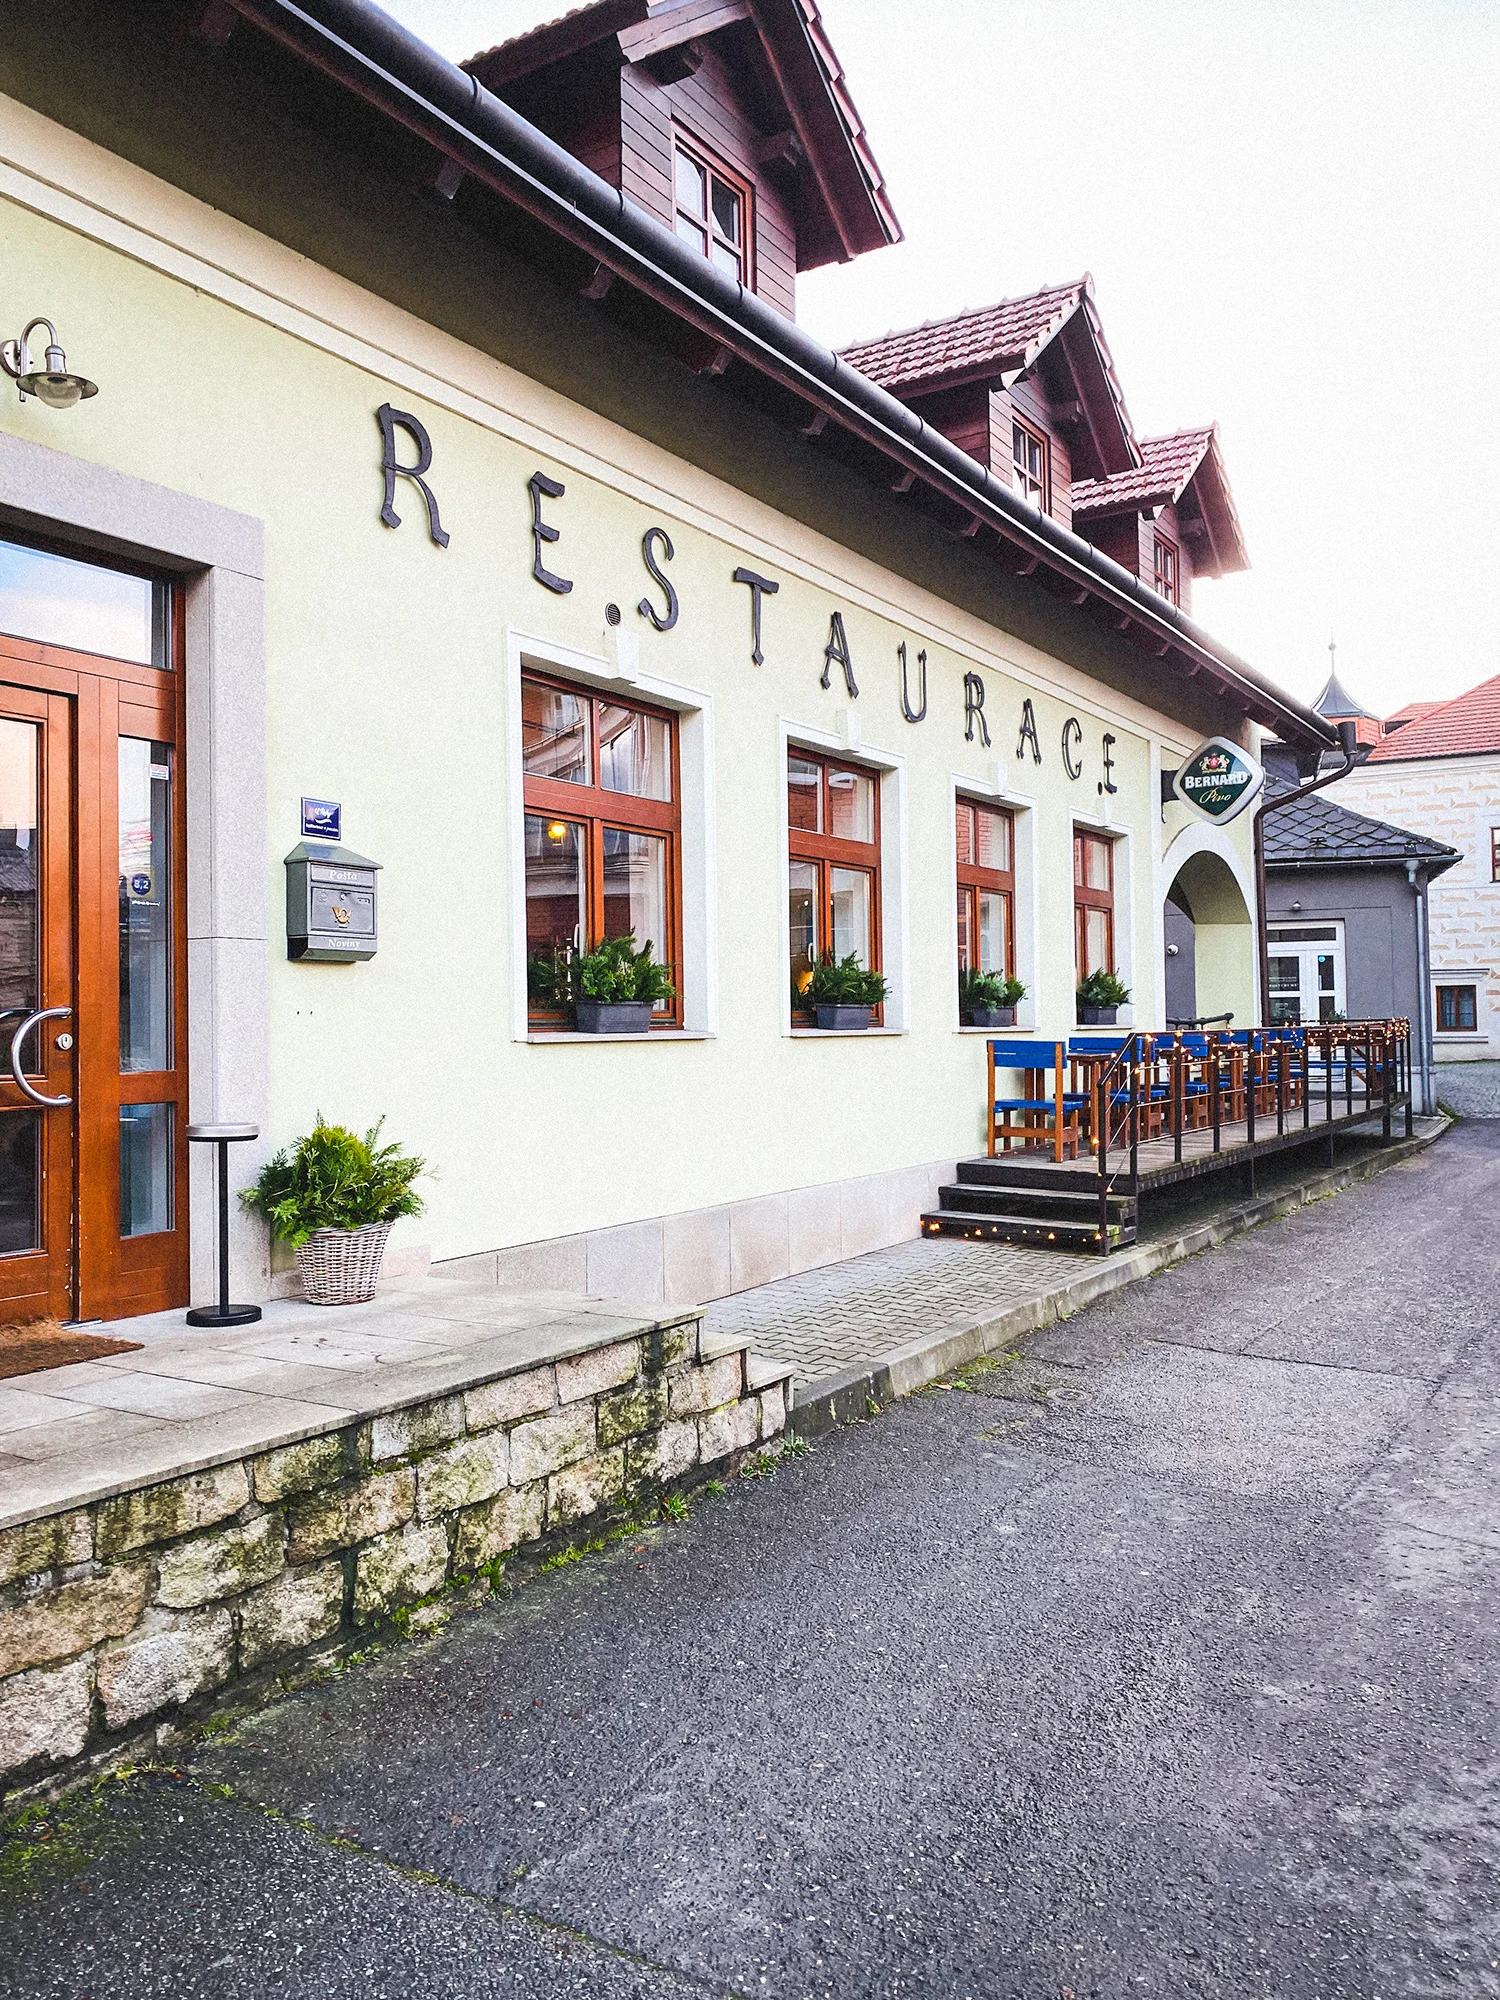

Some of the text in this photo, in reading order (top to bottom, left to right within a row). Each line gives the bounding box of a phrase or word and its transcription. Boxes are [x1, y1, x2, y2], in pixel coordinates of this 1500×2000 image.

[376, 402, 1118, 796] RESTAURACE
[1184, 770, 1249, 790] BERNARD
[1199, 786, 1232, 804] Pivo
[329, 870, 358, 881] Pošta
[133, 879, 150, 890] 8,2
[328, 938, 361, 950] Noviny
